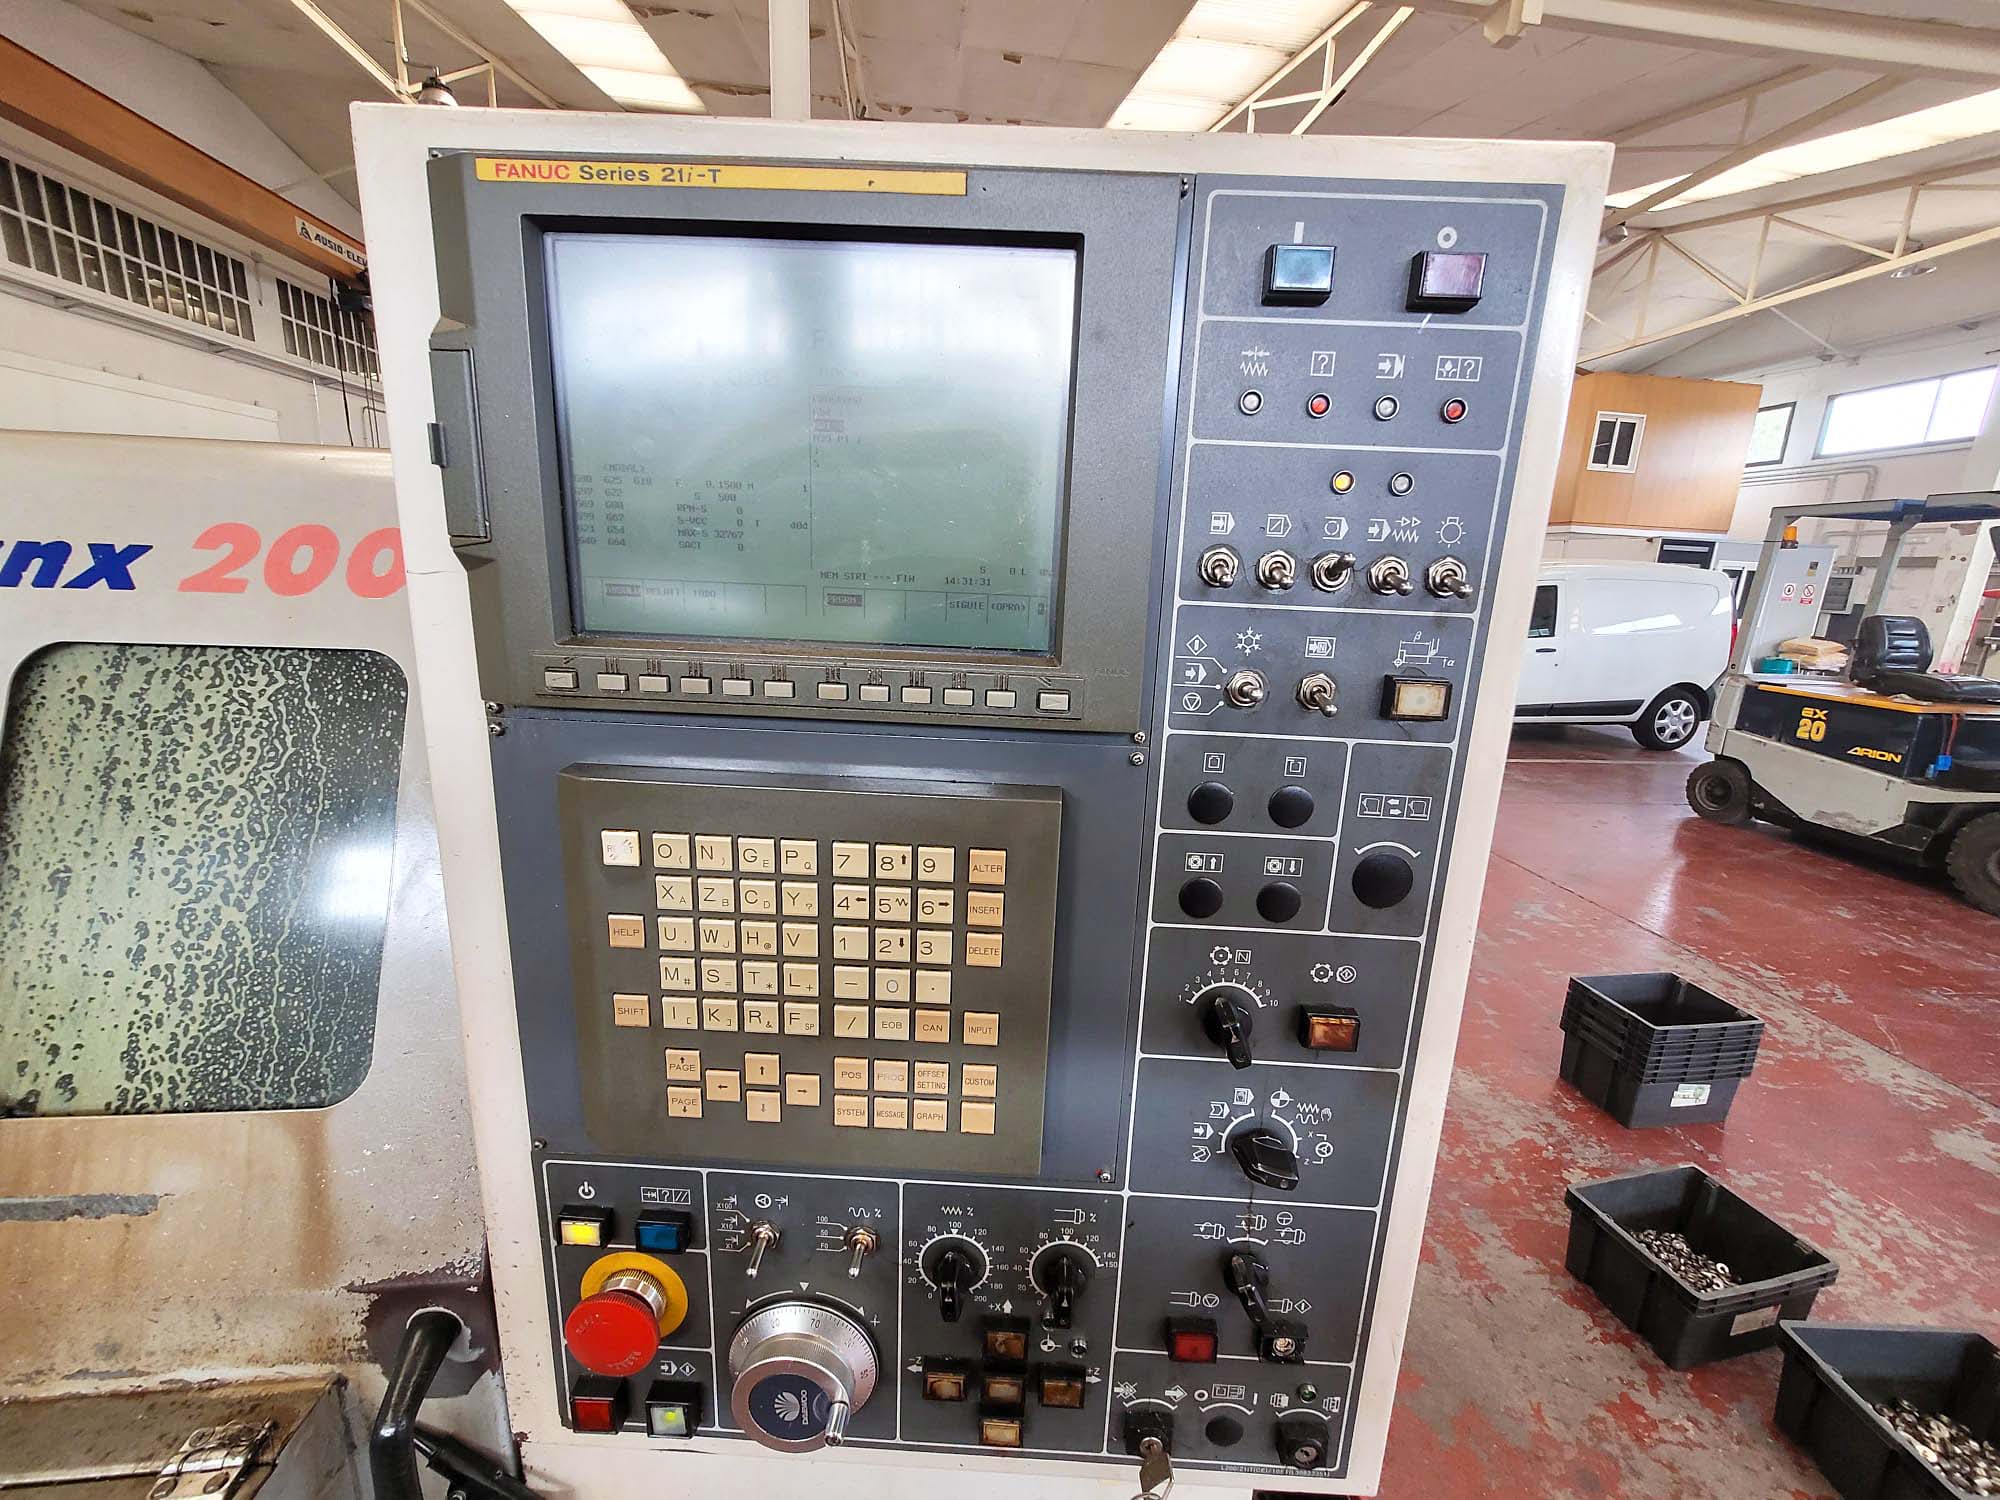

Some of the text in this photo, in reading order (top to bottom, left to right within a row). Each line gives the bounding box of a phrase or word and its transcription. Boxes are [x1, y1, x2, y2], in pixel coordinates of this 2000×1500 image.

[495, 163, 721, 183] FANUC Series 21i-T
[0, 522, 407, 599] nx 200
[1796, 718, 1826, 742] 20
[1847, 746, 1902, 763] ARION
[701, 846, 713, 860] N
[742, 848, 758, 863] G
[785, 850, 799, 865] P
[836, 854, 851, 869] 7
[880, 857, 895, 872] 8
[922, 858, 936, 873] 9
[972, 865, 1003, 874] ALTER
[661, 884, 674, 900] X
[703, 887, 717, 902] Z
[744, 890, 759, 905] C
[787, 891, 800, 906] Y
[836, 896, 851, 911] 4
[878, 898, 892, 914] 5
[921, 901, 935, 916] 6
[969, 906, 1000, 915] INSERT
[613, 928, 640, 937] HELP
[664, 927, 677, 941] U
[703, 929, 719, 944] W
[746, 931, 759, 945] H
[786, 932, 800, 947] V
[839, 937, 847, 952] 1
[879, 939, 892, 954] 2
[920, 941, 934, 956] 3
[968, 947, 1000, 956] DELETE
[664, 967, 679, 981] M
[706, 969, 720, 983] S
[1207, 970, 1212, 978] 4
[1220, 968, 1225, 976] 5
[1234, 968, 1239, 976] 6
[748, 971, 761, 985] T
[789, 973, 801, 988] L
[1184, 984, 1190, 992] 2
[1269, 999, 1279, 1007] 10
[617, 1007, 645, 1016] SHIFT
[708, 1008, 721, 1023] K
[749, 1010, 762, 1024] R
[789, 1012, 801, 1026] F
[881, 1021, 903, 1030] EOB
[922, 1024, 943, 1033] CAN
[968, 1026, 993, 1035] INPUT
[669, 1064, 696, 1072] PAGE
[841, 1071, 862, 1080] POS
[877, 1073, 905, 1083] PROG
[917, 1070, 945, 1079] OFFSET
[917, 1081, 946, 1090] SETTING
[964, 1078, 995, 1087] CUSTOM
[671, 1097, 697, 1106] PAGE
[836, 1108, 866, 1117] SYSTEM
[876, 1110, 905, 1119] MESSAGE
[916, 1112, 944, 1121] GRAPH
[927, 1225, 937, 1233] 80
[948, 1221, 962, 1229] 100
[973, 1228, 987, 1236] 120
[1038, 1232, 1049, 1240] 80
[1060, 1227, 1074, 1236] 100
[1085, 1235, 1099, 1243] 120
[996, 1263, 1010, 1271] 160
[990, 1283, 1003, 1291] 180
[1017, 1284, 1027, 1292] 20
[974, 1295, 987, 1303] 200
[800, 1389, 809, 1425] DAEWOO
